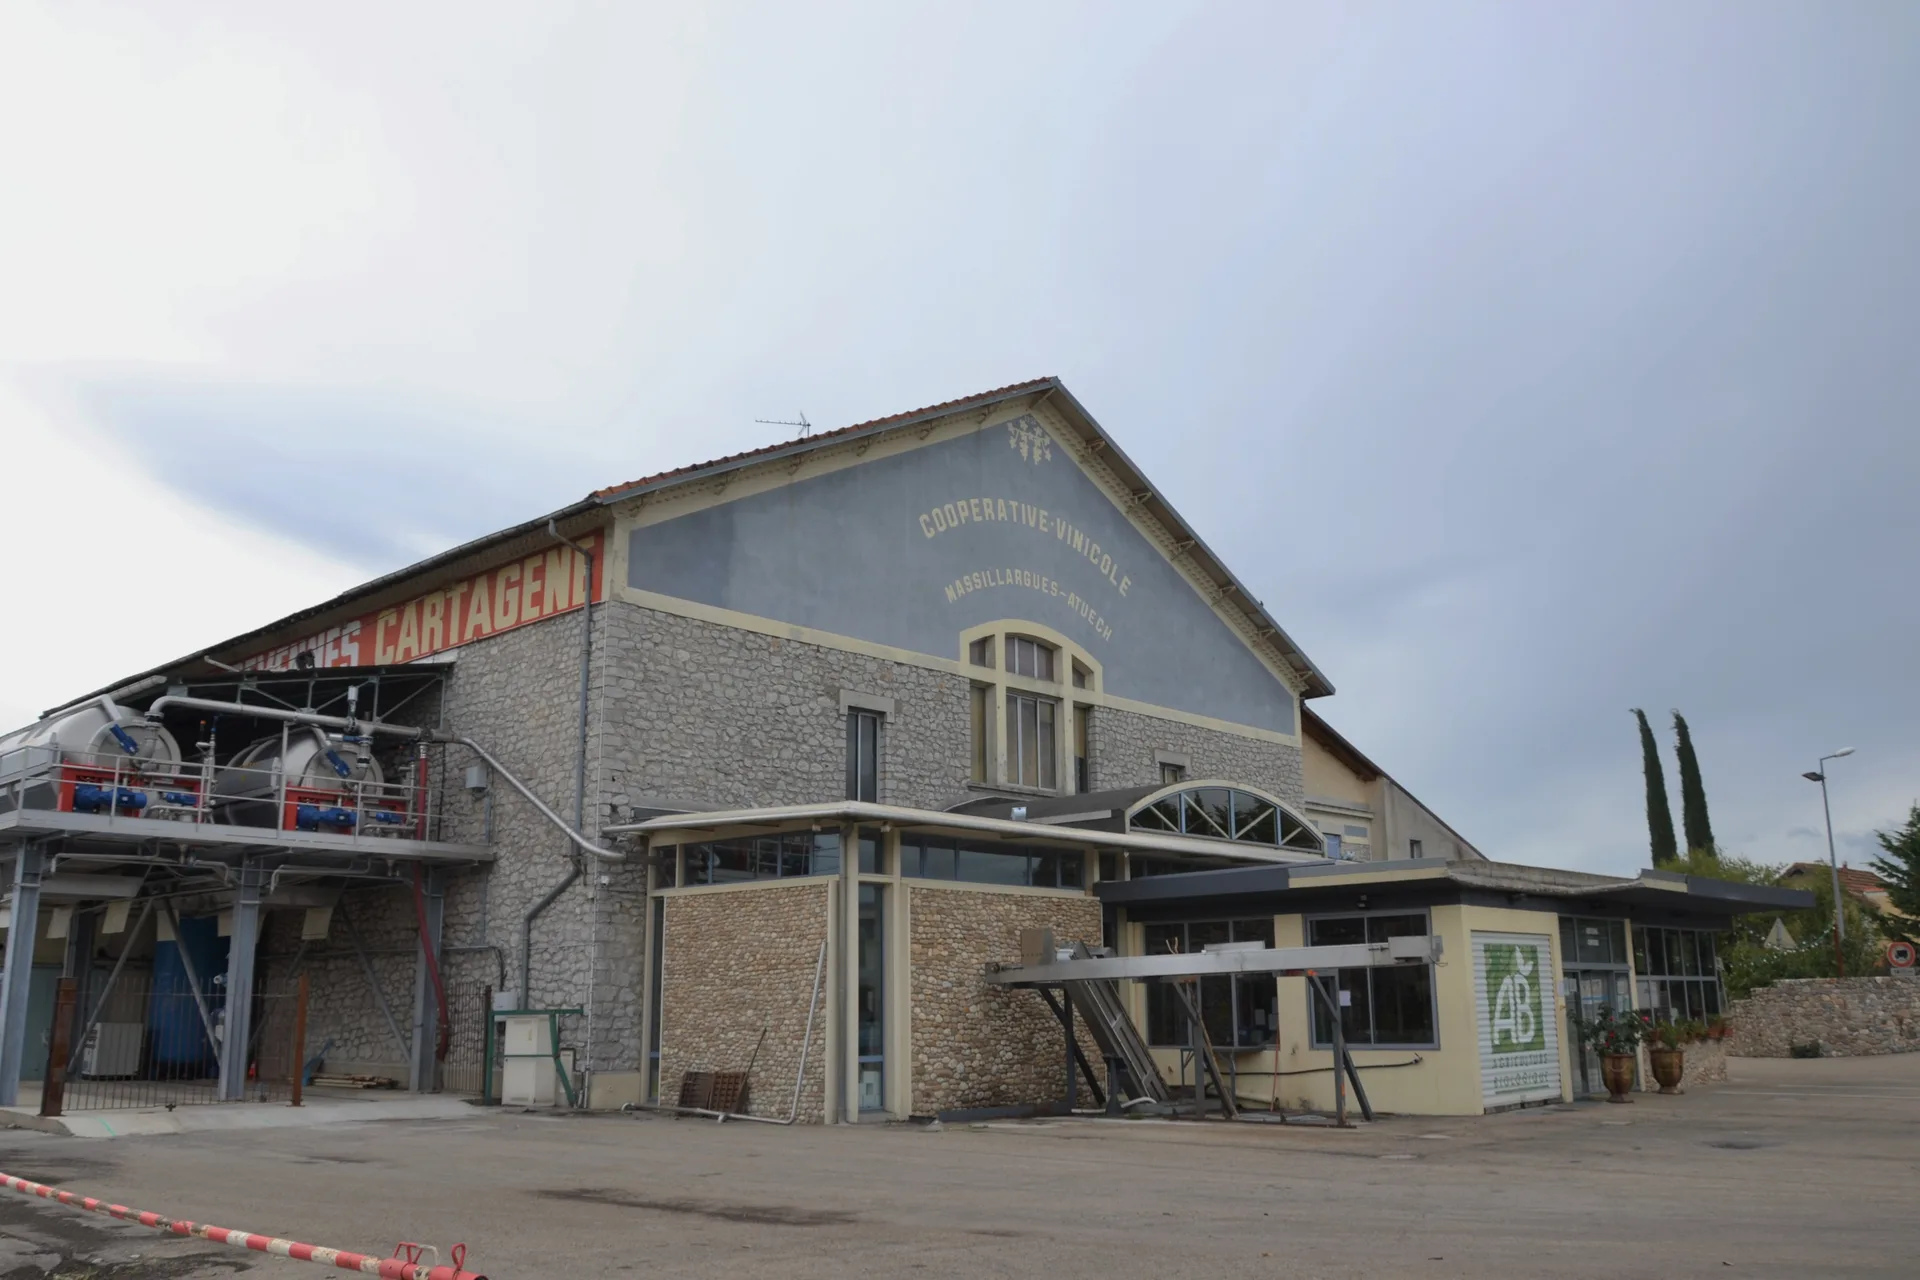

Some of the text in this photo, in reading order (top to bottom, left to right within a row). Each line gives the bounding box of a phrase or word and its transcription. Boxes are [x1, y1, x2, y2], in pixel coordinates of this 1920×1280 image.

[1056, 517, 1132, 597] VINICOLE
[374, 535, 595, 666] CARTAGENE
[1493, 973, 1536, 1045] AB
[1491, 1053, 1548, 1069] AGRICULTURE
[1493, 1071, 1548, 1089] BIOLOGIQUE
